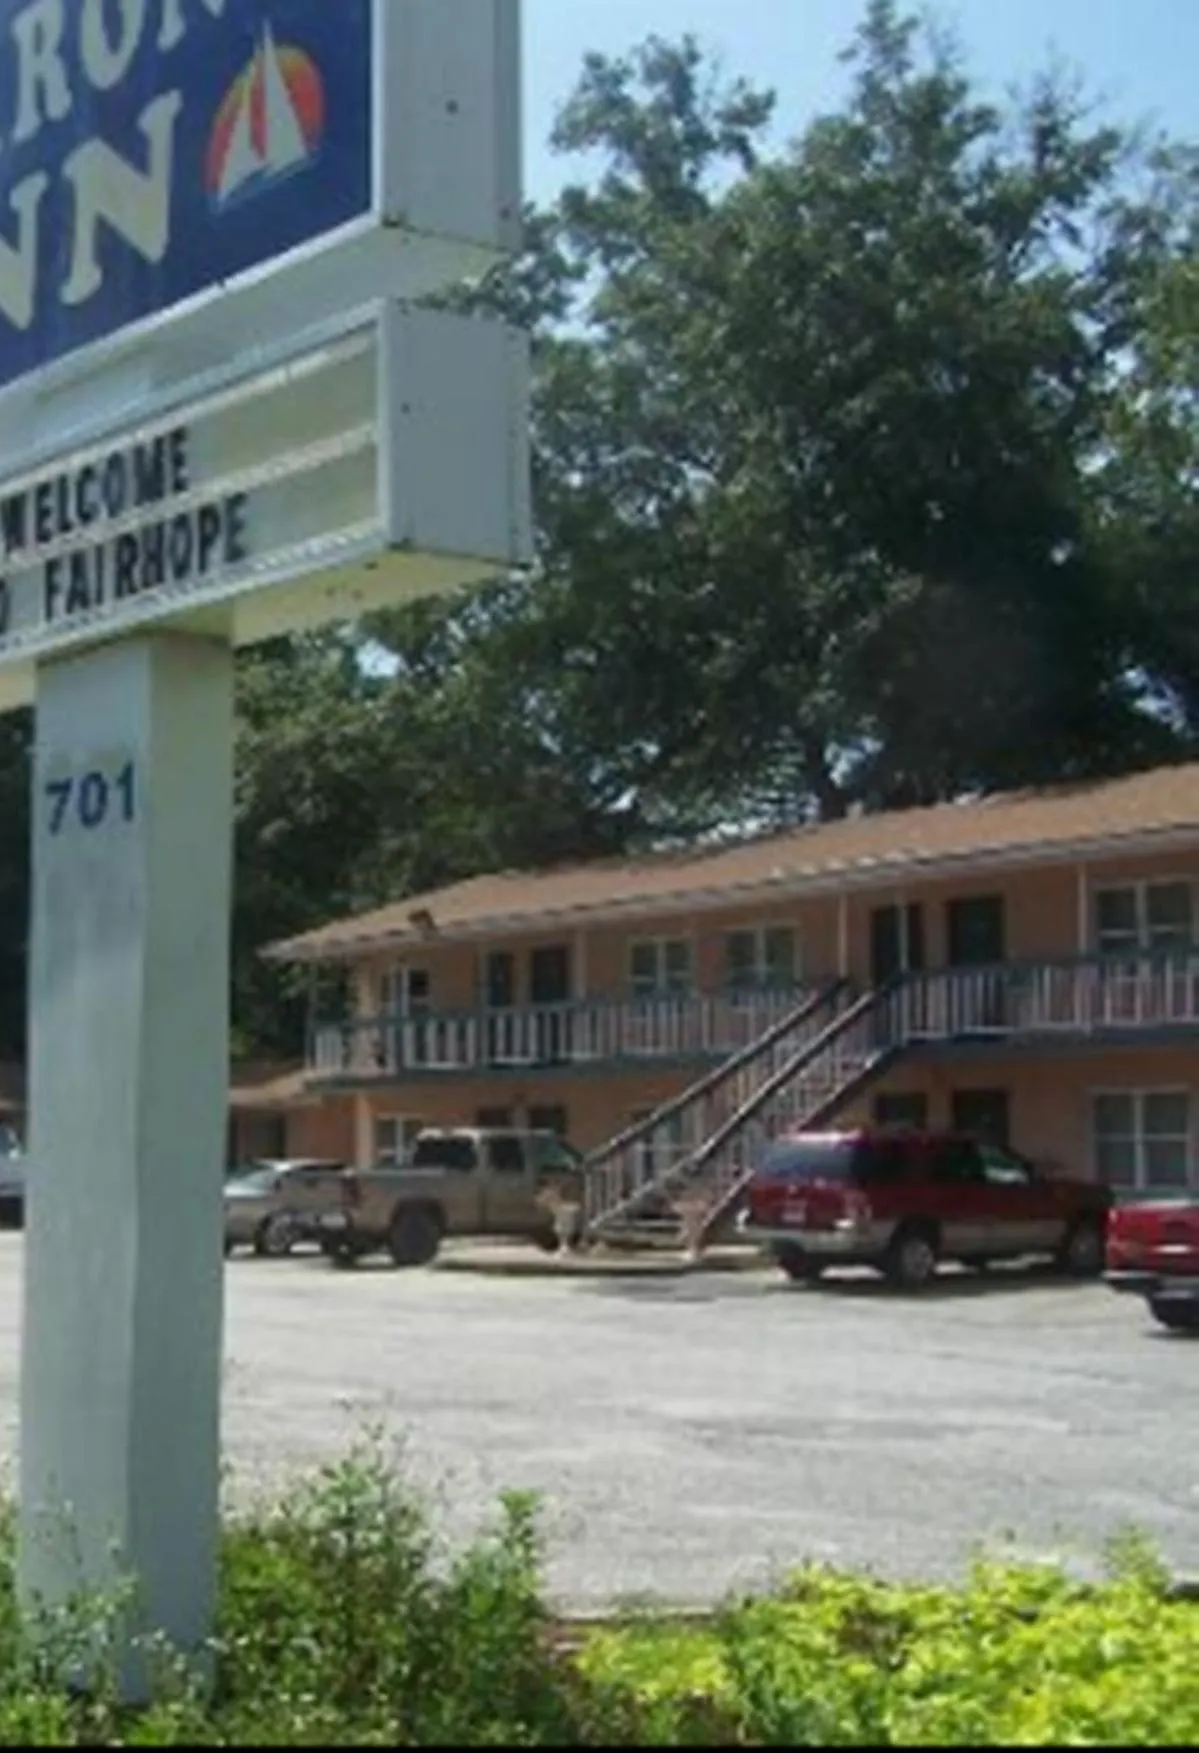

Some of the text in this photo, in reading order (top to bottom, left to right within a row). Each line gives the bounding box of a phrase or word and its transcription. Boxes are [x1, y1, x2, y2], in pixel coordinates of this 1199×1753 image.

[0, 425, 187, 552] WELCOME
[45, 492, 249, 622] FAIRHOPE
[45, 759, 135, 837] 701
